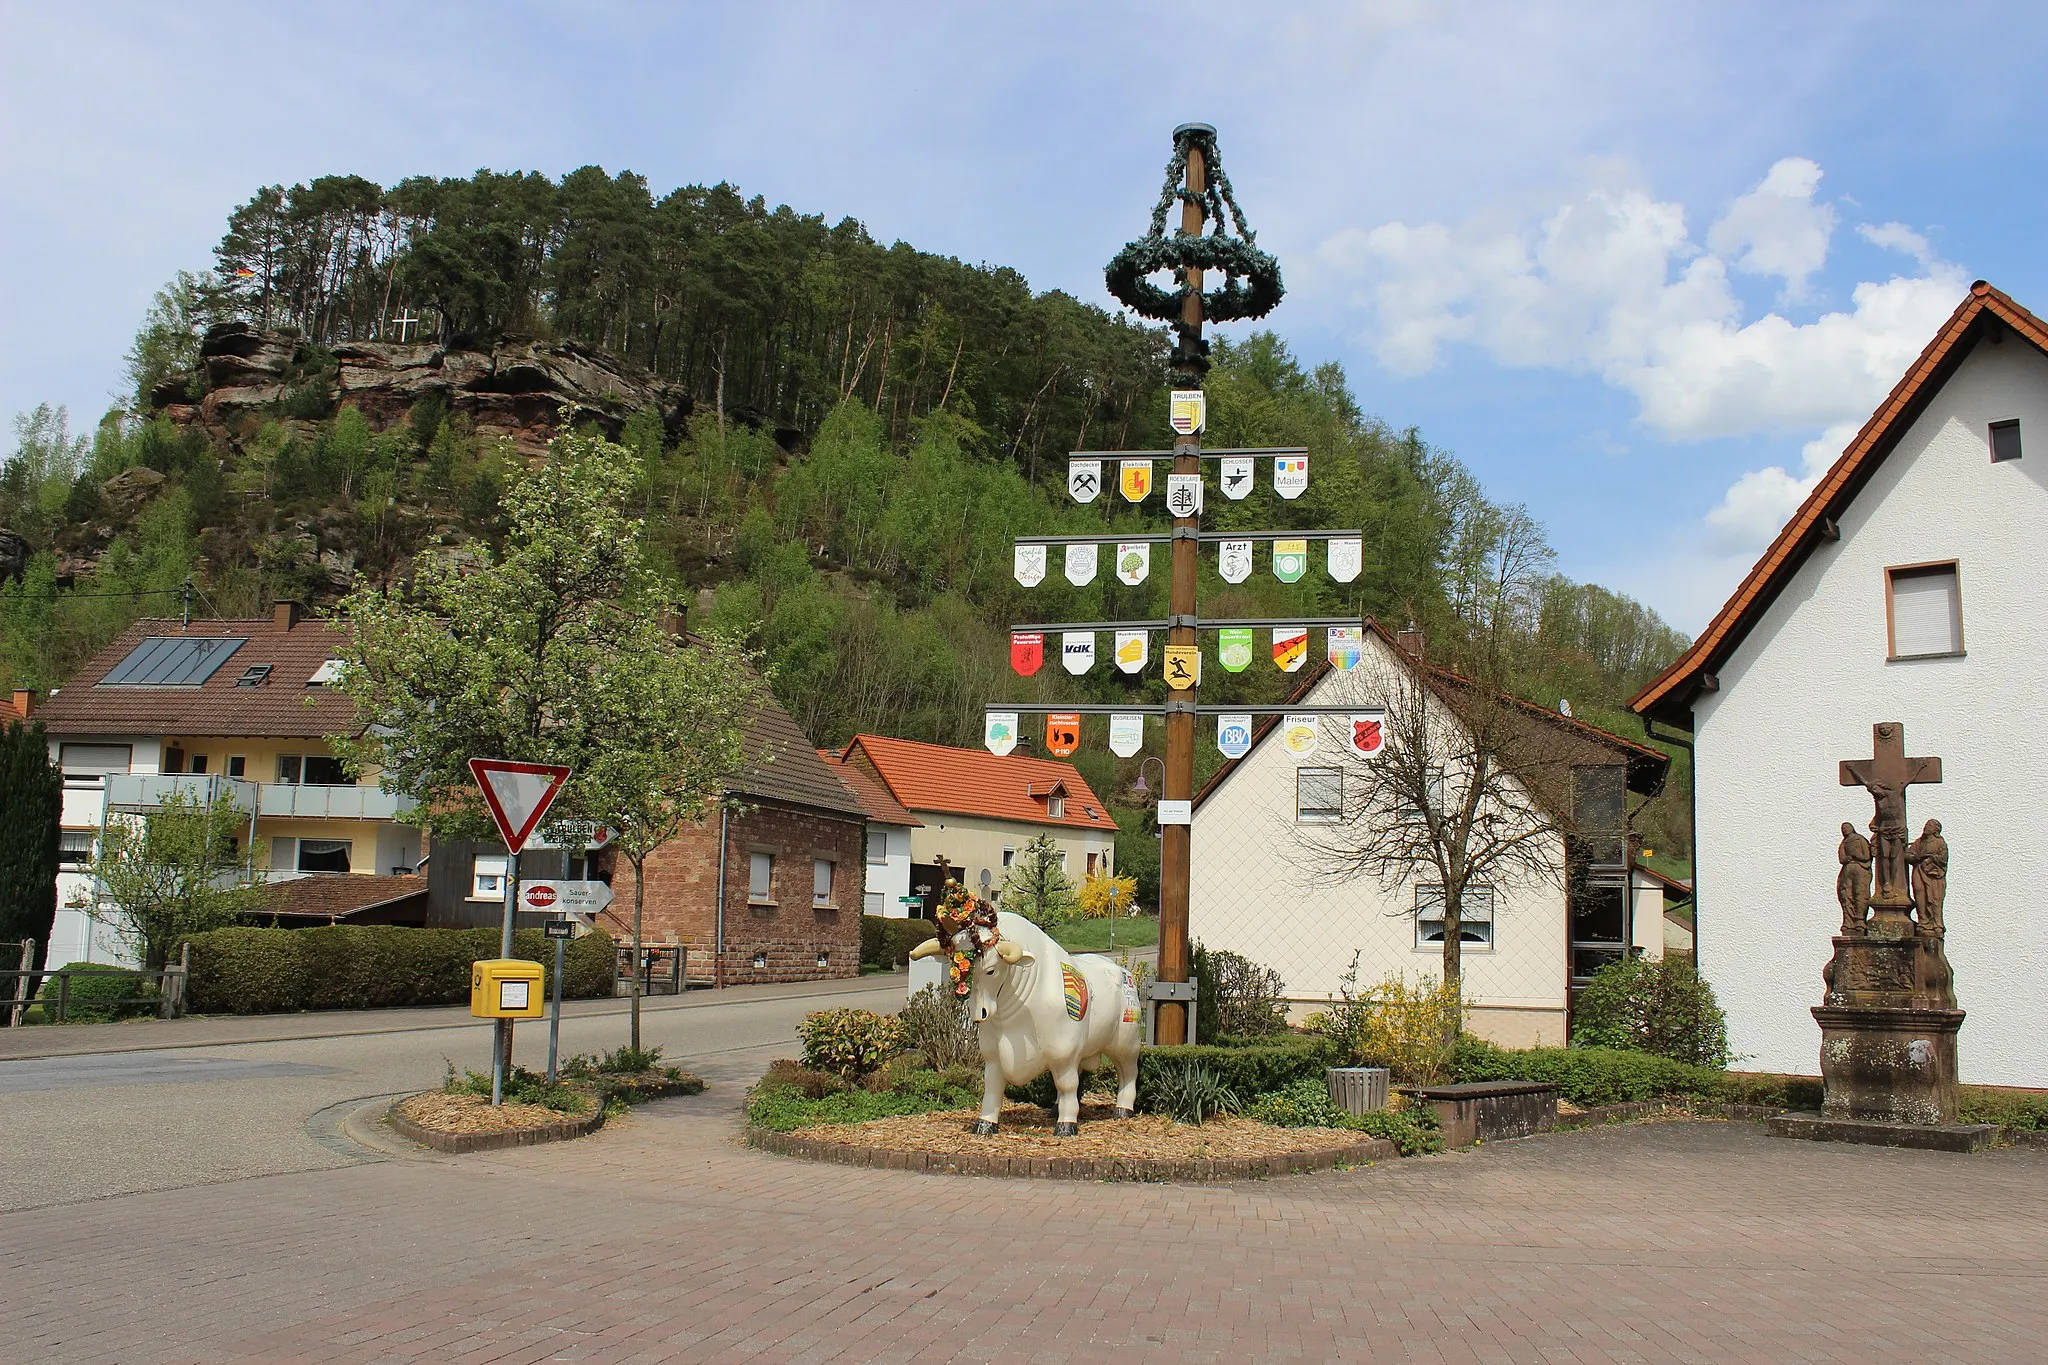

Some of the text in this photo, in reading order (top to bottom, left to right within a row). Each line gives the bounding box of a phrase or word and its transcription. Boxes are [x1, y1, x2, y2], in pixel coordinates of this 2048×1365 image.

[1277, 476, 1304, 485] Maler
[1226, 543, 1247, 551] Arzt
[1065, 645, 1092, 654] VdK
[1225, 729, 1247, 744] BBV
[525, 890, 557, 900] andreas
